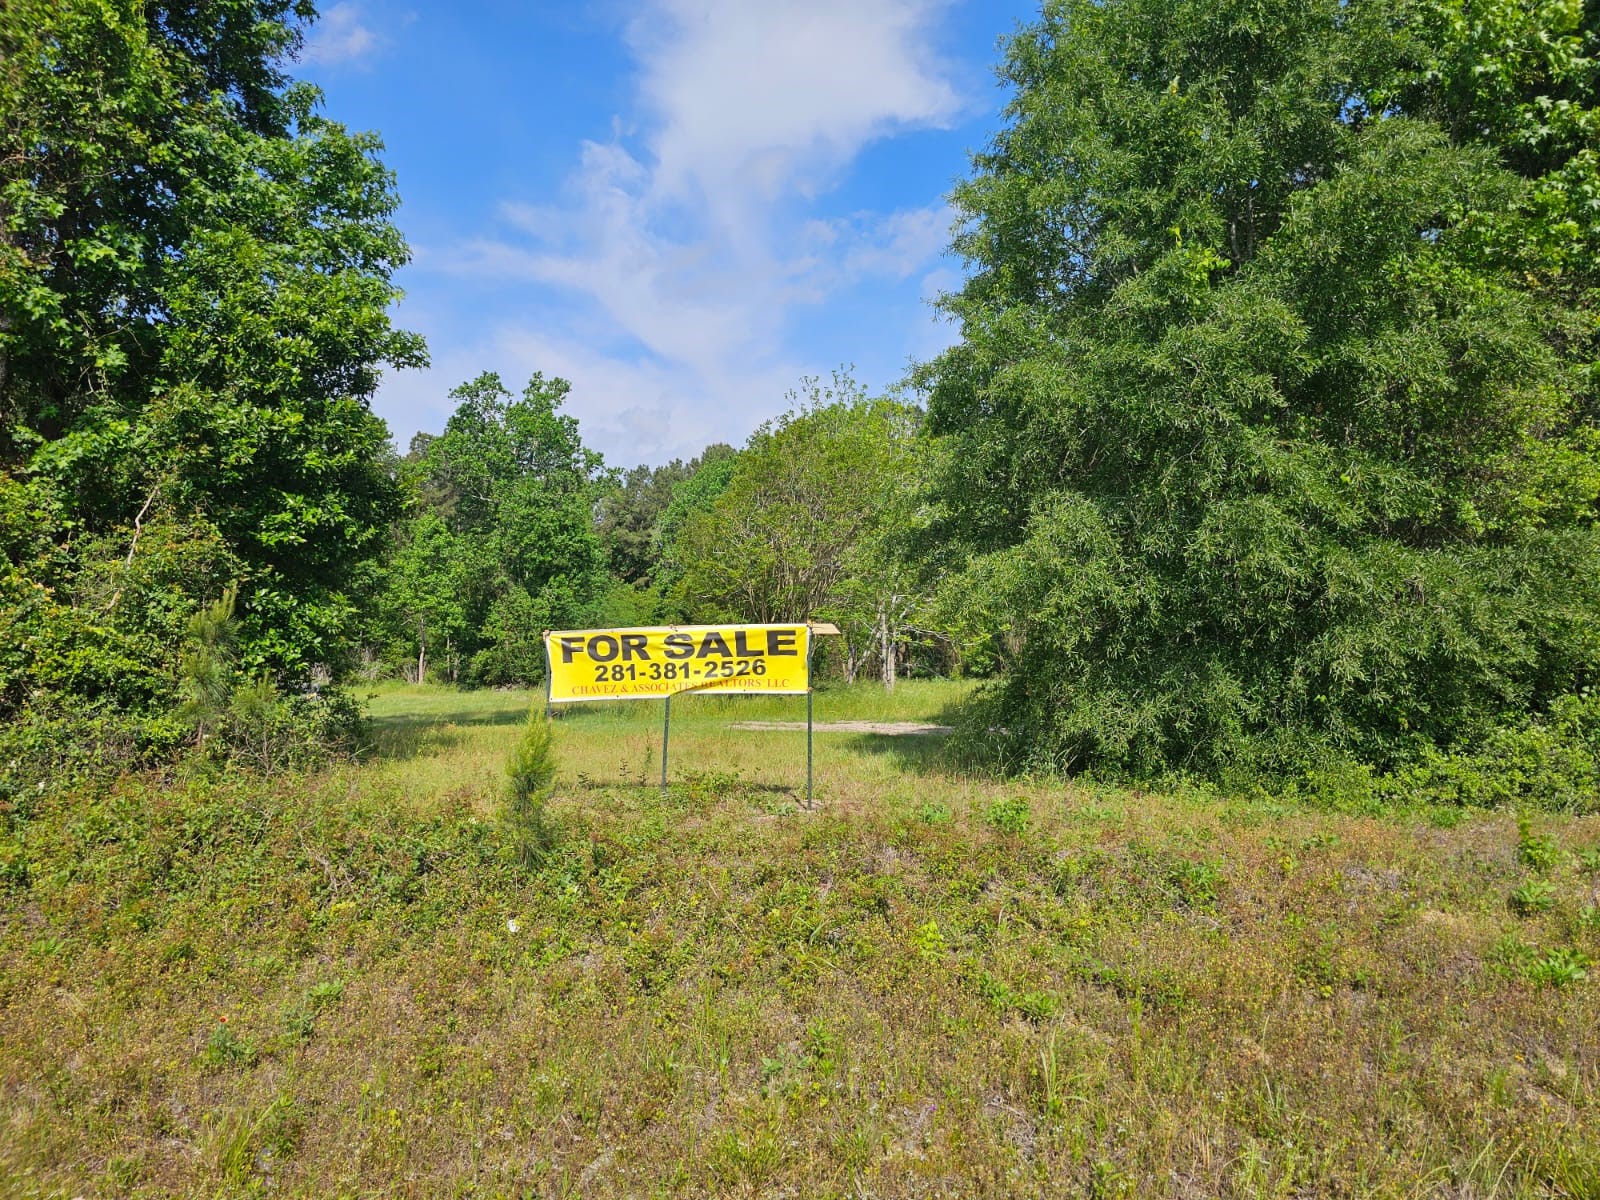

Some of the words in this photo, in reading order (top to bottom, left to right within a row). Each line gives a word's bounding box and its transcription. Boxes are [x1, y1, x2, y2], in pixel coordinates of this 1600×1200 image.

[561, 634, 651, 663] FOR
[664, 630, 798, 659] SALE
[594, 659, 767, 682] 281-381-2526
[572, 685, 619, 695] CHAVEZ
[620, 685, 628, 693] &
[632, 682, 697, 692] ASSOCIATES
[767, 678, 789, 688] LLC
